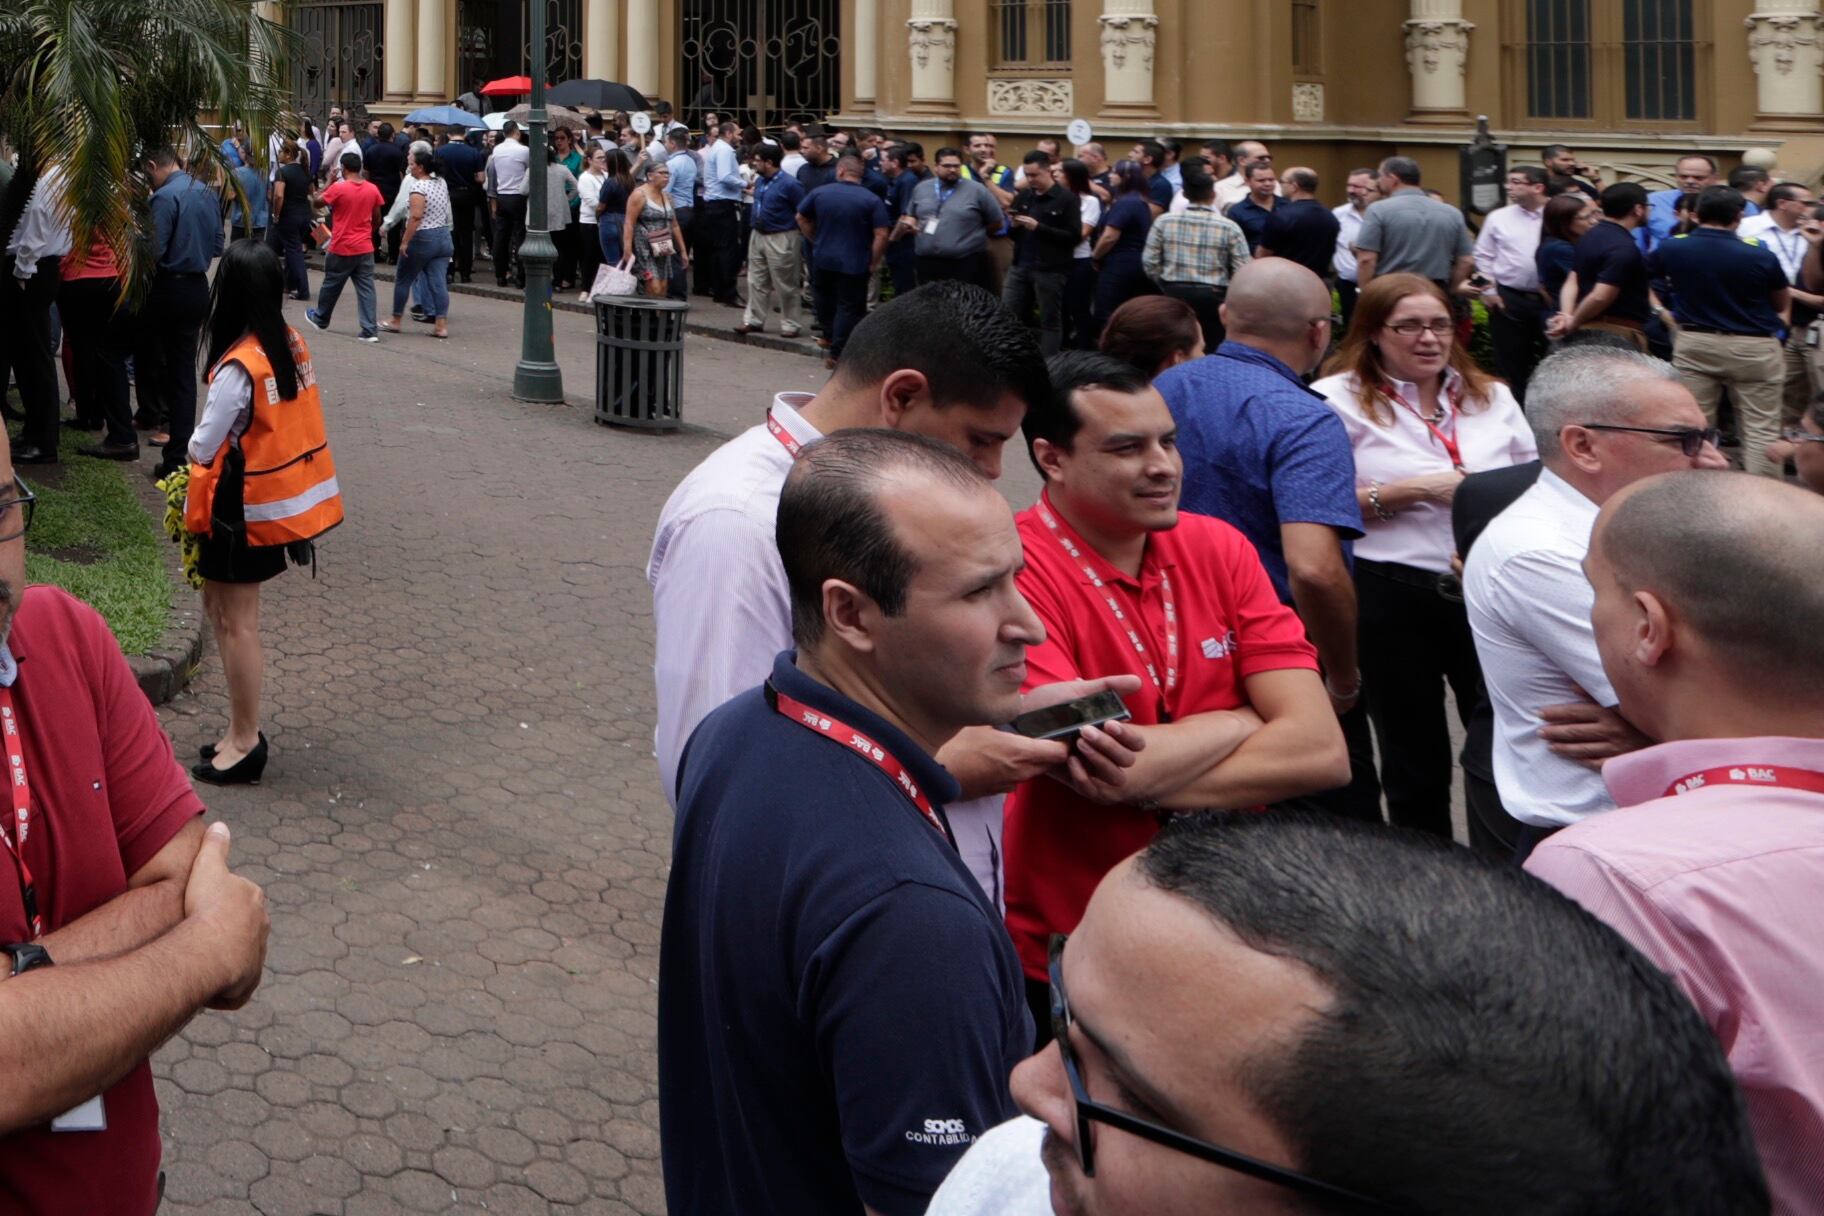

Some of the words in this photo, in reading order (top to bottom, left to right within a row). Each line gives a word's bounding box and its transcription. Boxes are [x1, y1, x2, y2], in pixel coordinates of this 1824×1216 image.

[803, 711, 819, 726] BAC
[5, 719, 16, 735] BAC
[850, 734, 872, 753] BAC
[14, 769, 25, 786] BAC
[1748, 768, 1775, 779] BAC
[1686, 775, 1705, 788] BAC
[924, 1118, 965, 1134] SOMOS
[905, 1131, 976, 1144] CONTABILIDA
